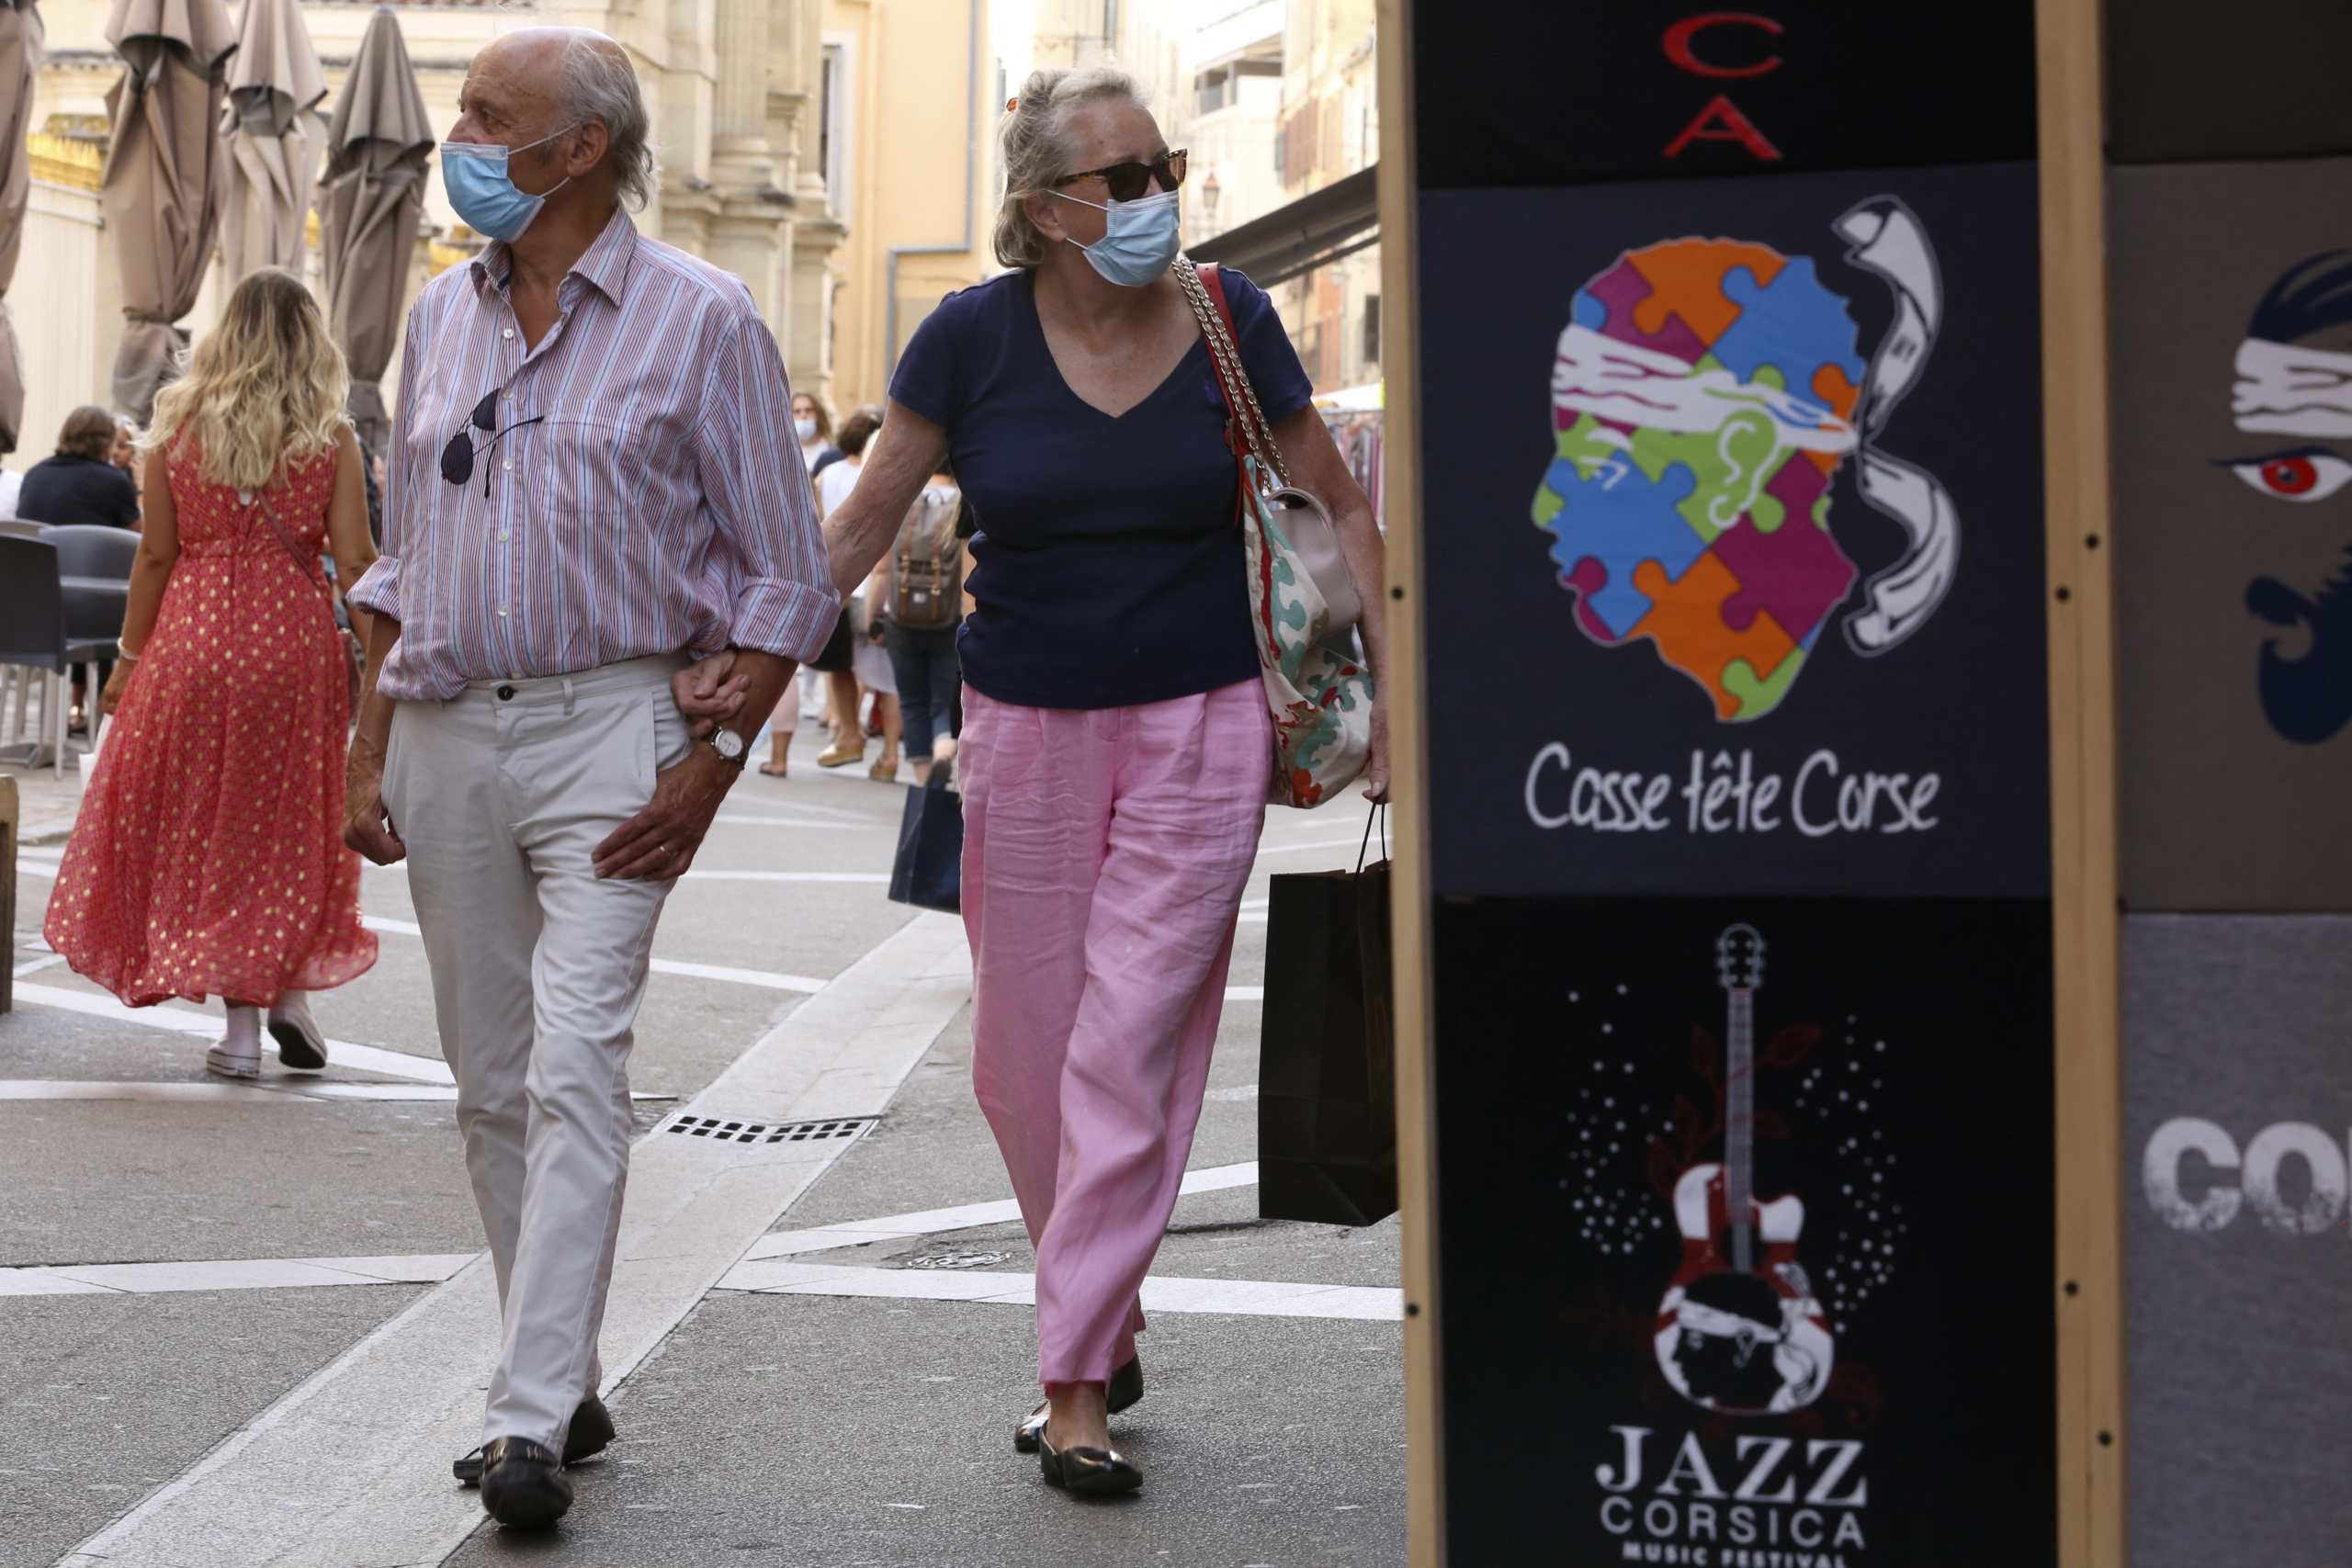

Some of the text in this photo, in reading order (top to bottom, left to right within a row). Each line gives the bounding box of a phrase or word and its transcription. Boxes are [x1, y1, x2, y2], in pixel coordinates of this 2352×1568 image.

[1525, 741, 1941, 837] Casse tête Corse
[2142, 1115, 2352, 1235] CO
[1595, 1425, 1868, 1507] JAZZ
[1600, 1495, 1866, 1550] CORSICA
[1622, 1540, 1848, 1568] MUSIC FESTIVAL
